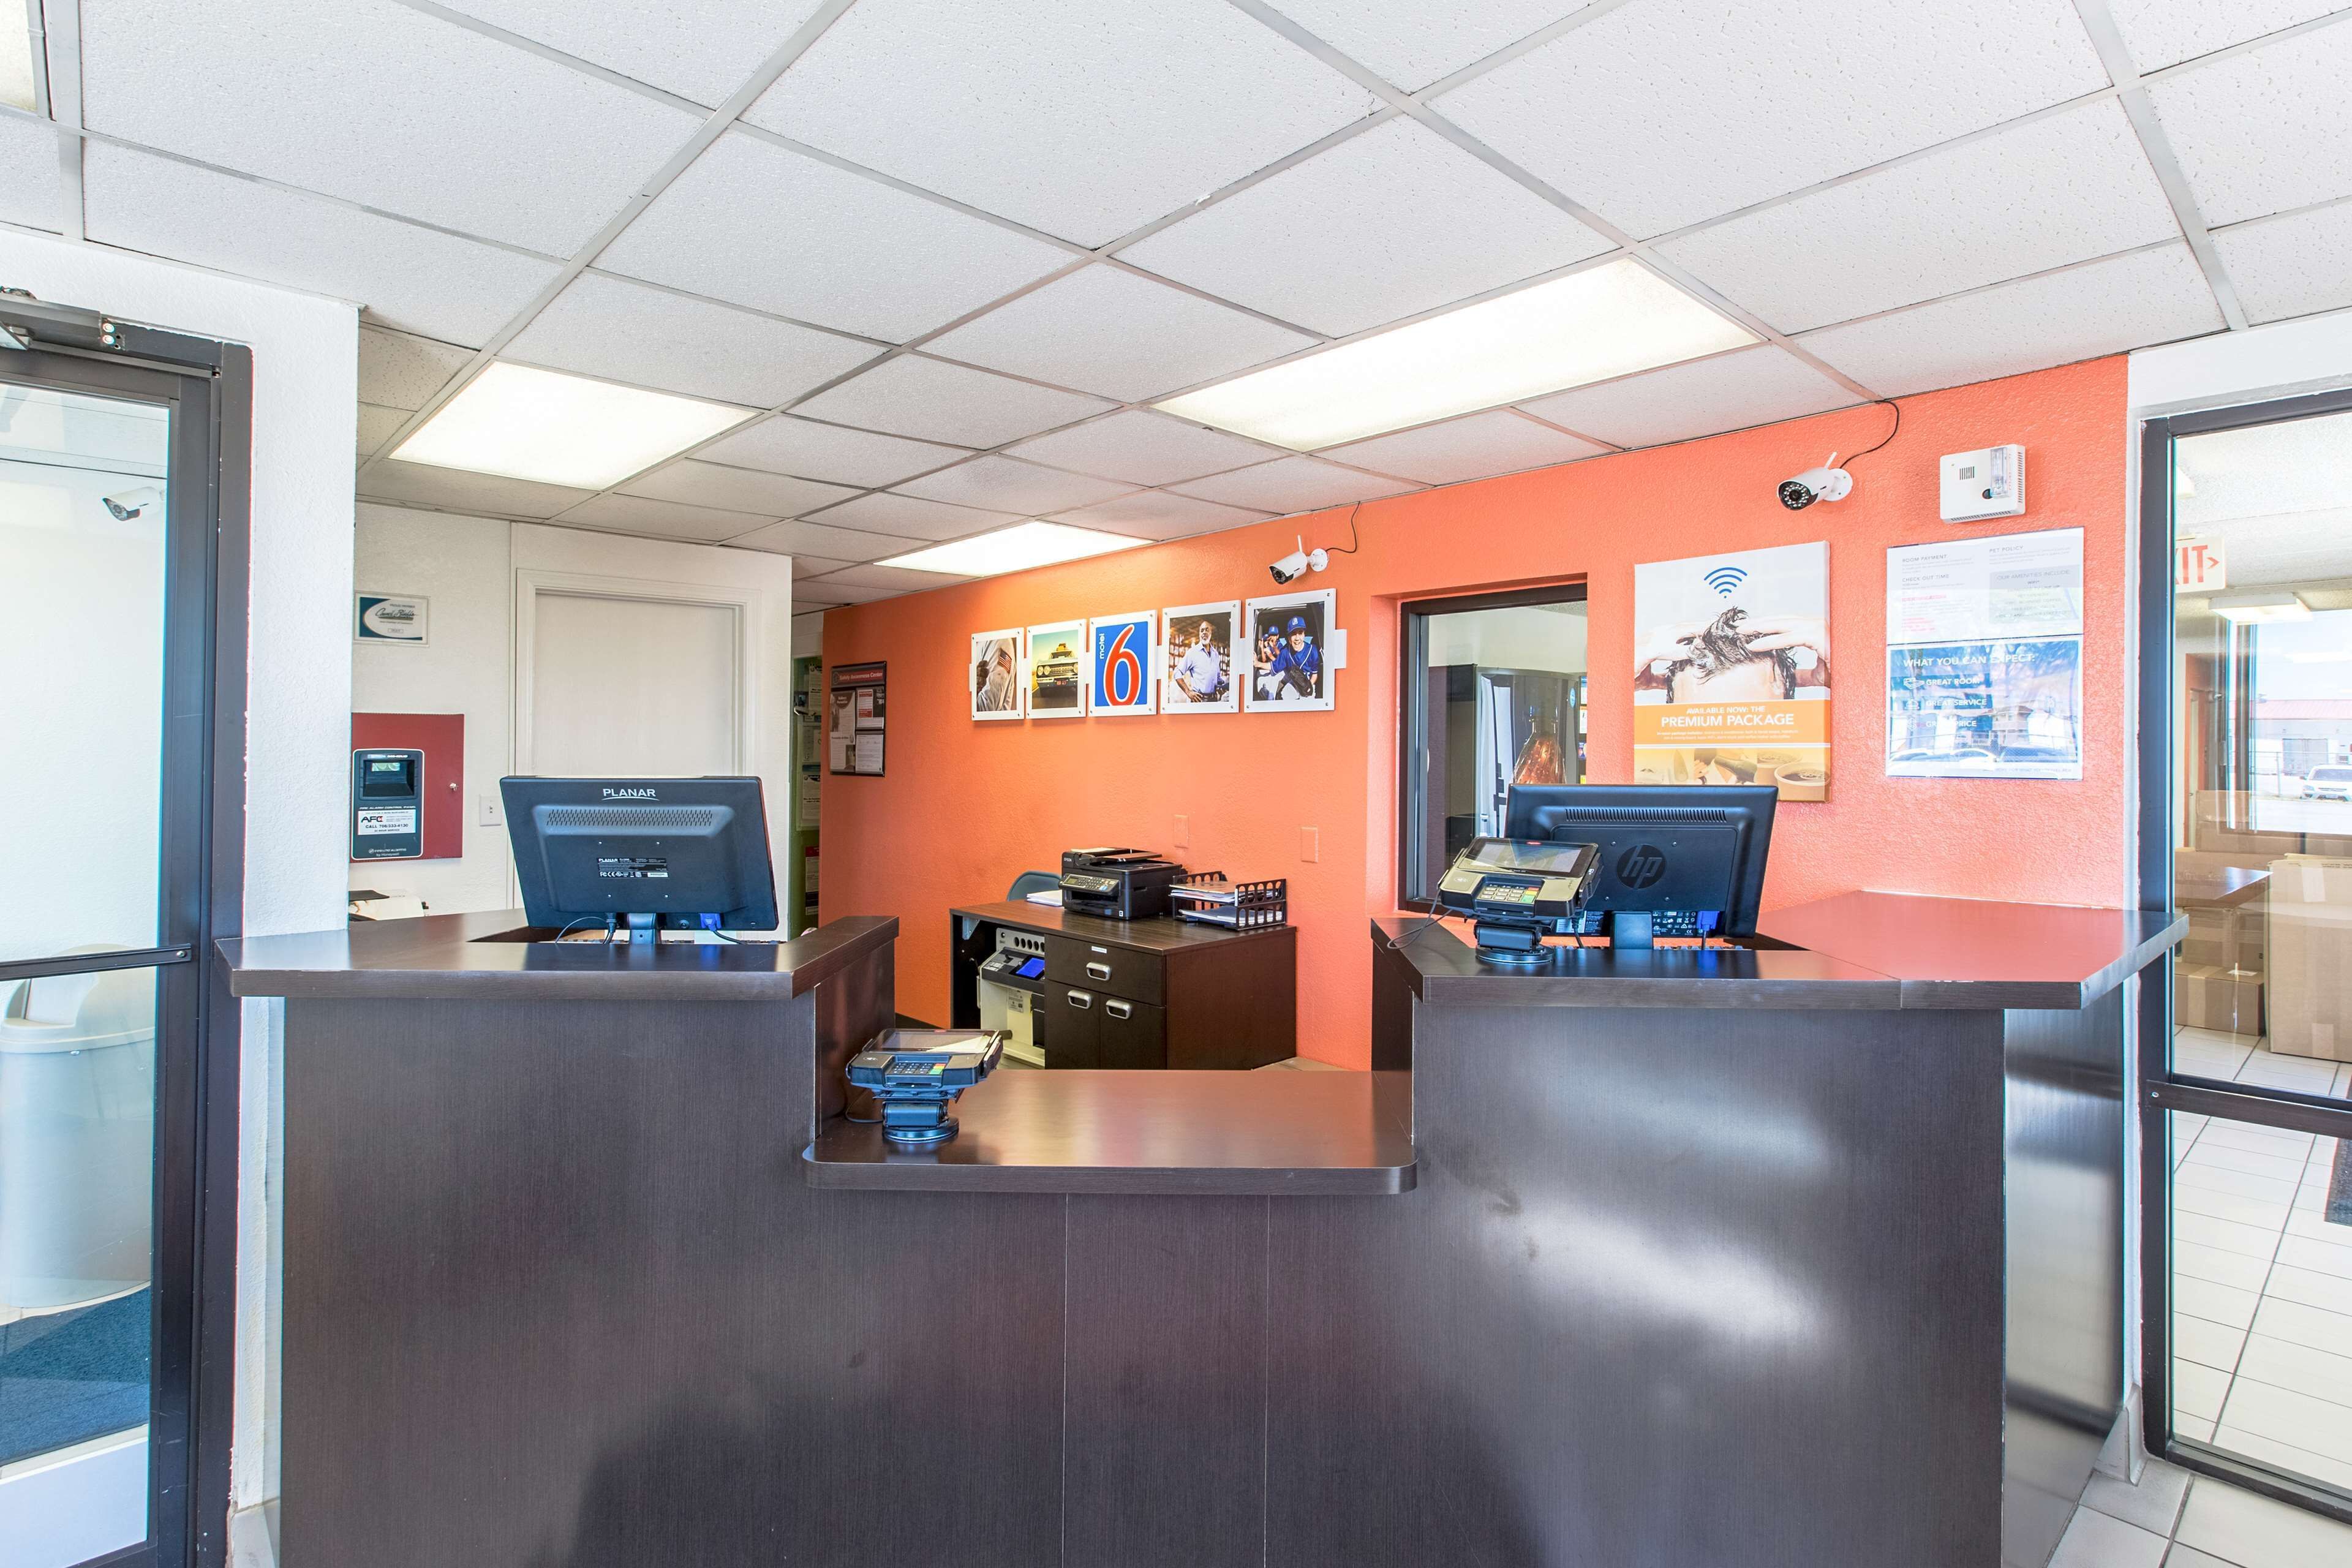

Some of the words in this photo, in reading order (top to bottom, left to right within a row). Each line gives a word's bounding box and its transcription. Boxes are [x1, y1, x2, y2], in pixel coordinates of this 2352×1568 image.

[1104, 624, 1142, 706] 6
[1903, 658, 1933, 667] WHAT
[1962, 656, 1986, 665] CAN
[1991, 654, 2035, 663] EXPECT:
[1661, 715, 1722, 727] PREMIUM
[1727, 714, 1794, 726] PACKAGE
[603, 788, 656, 797] PLANAR
